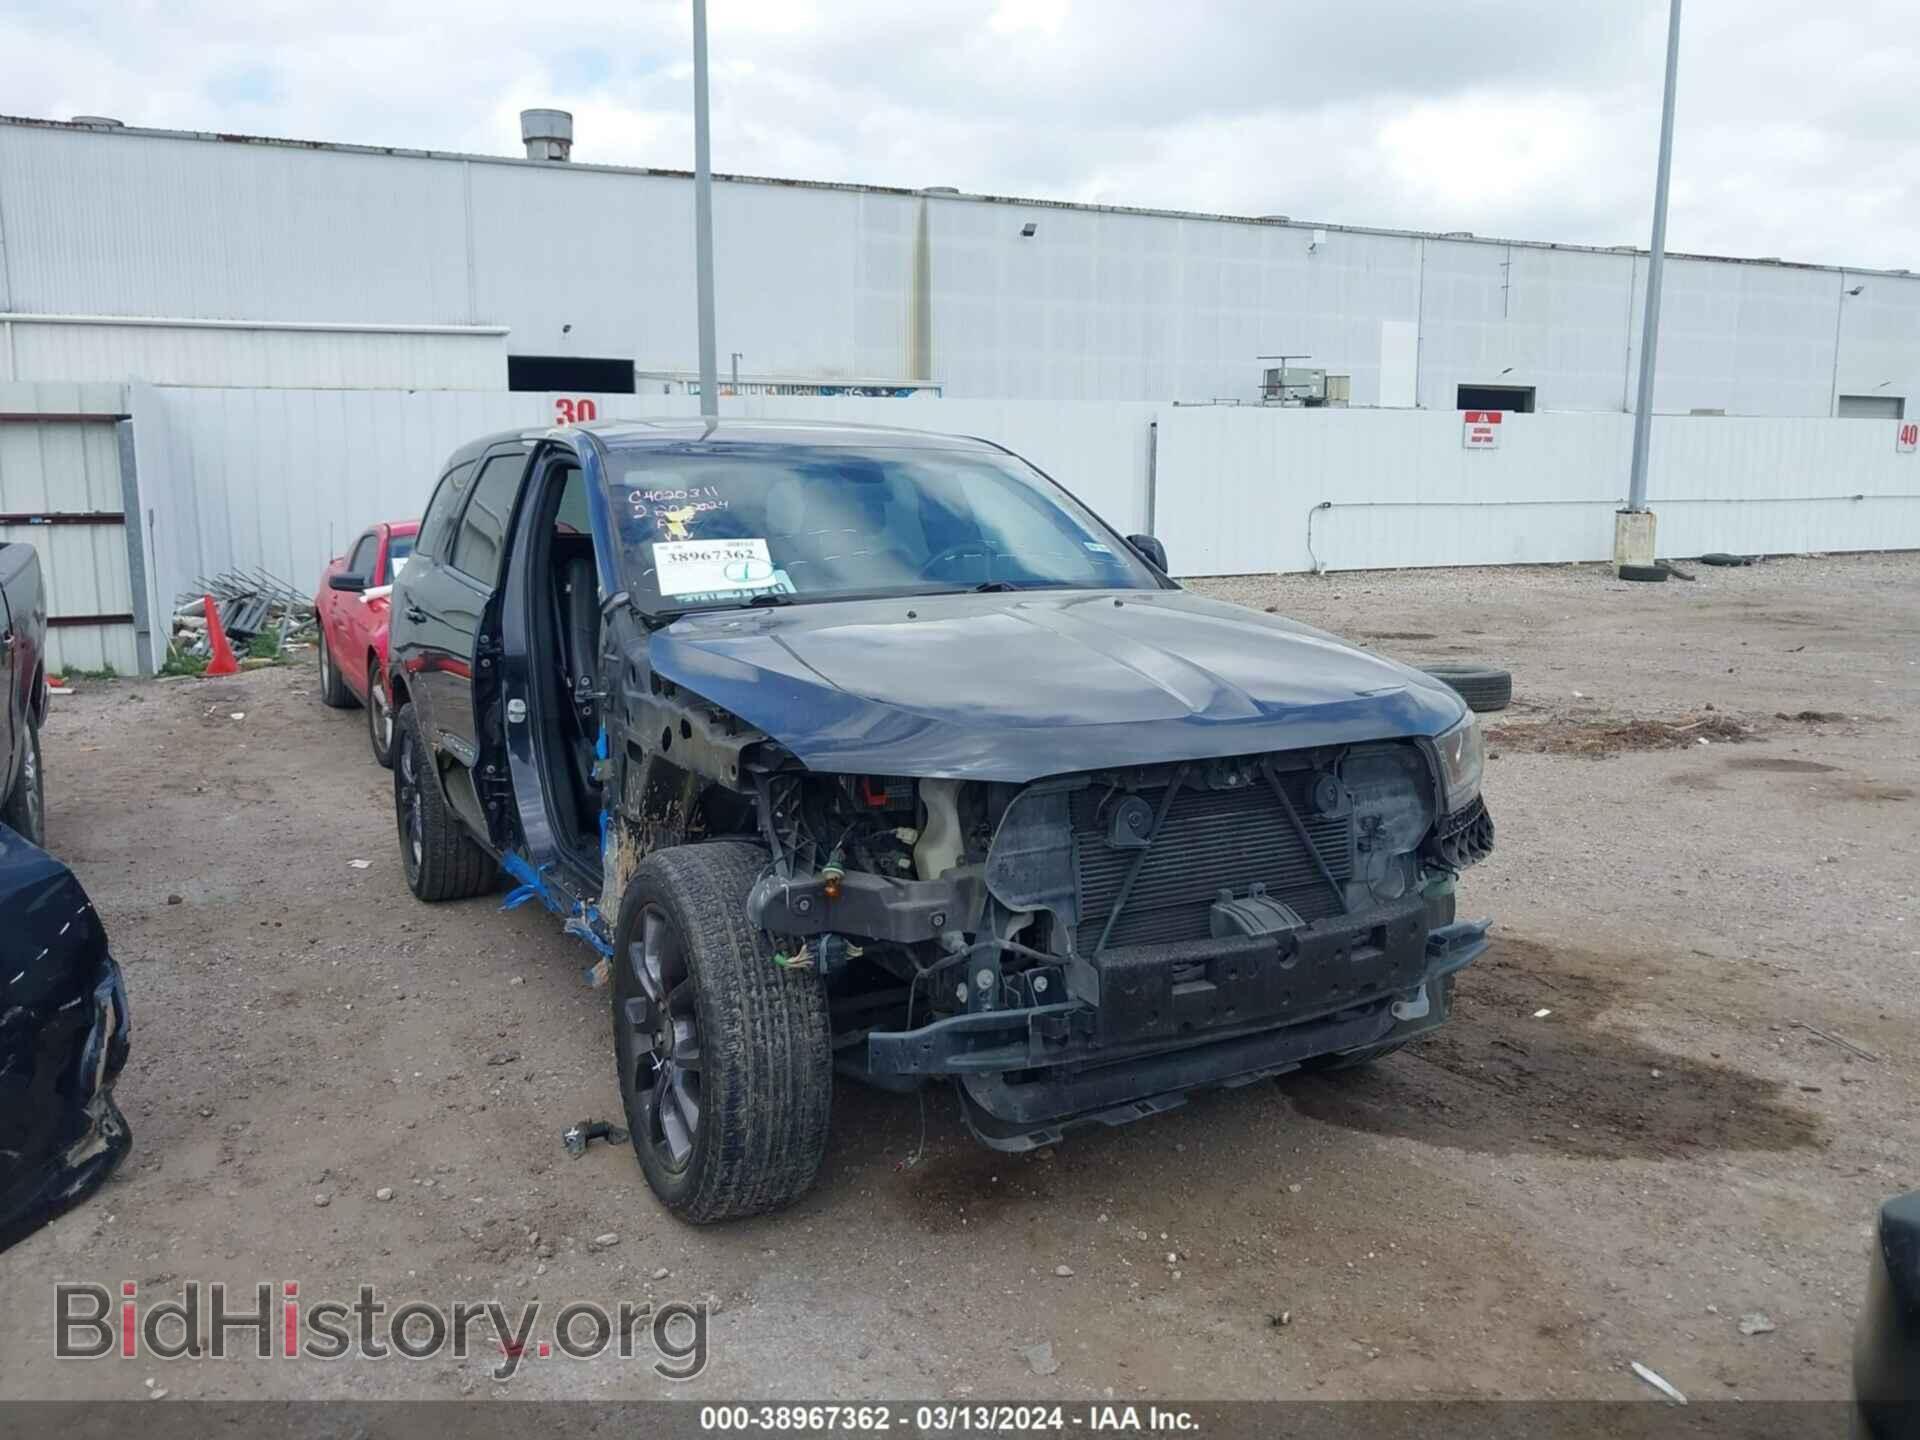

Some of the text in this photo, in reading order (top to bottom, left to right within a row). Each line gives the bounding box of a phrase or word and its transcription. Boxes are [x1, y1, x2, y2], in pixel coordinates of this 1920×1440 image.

[556, 399, 596, 424] 30
[1901, 425, 1918, 444] 40
[668, 549, 757, 564] 38967362
